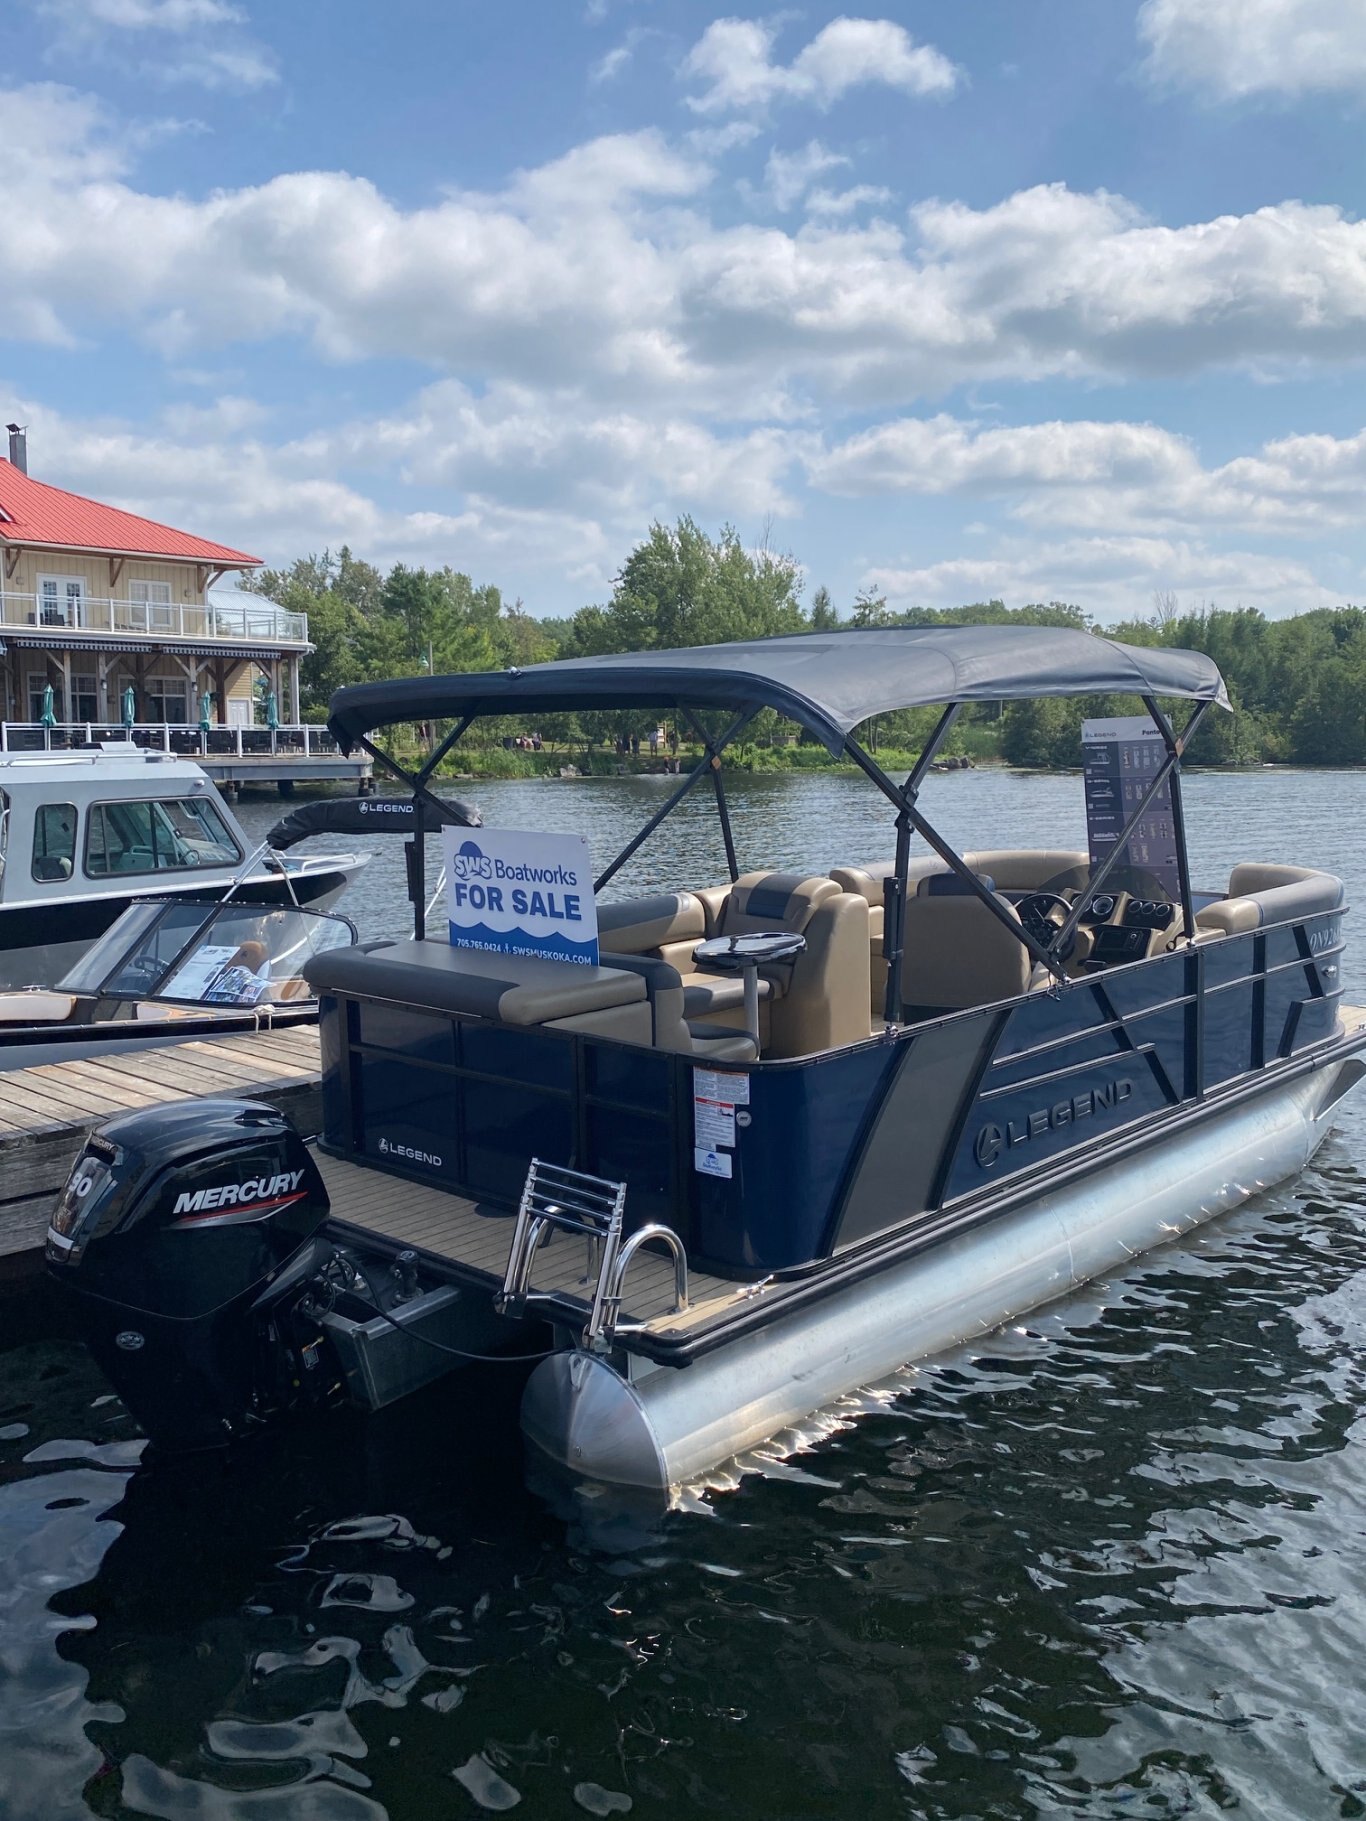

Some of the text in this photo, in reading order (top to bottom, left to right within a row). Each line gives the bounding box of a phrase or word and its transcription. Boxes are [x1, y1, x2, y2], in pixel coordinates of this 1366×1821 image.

[369, 803, 414, 813] LEGEND
[454, 853, 578, 887] SWS Boatworks
[454, 882, 582, 921] FOR SALE
[456, 937, 592, 966] 705.765.0424 SWSMUSKOKA.COM
[1006, 1078, 1135, 1149] LEGEND
[390, 1142, 442, 1167] LEGEND
[172, 1168, 305, 1214] MERCURY
